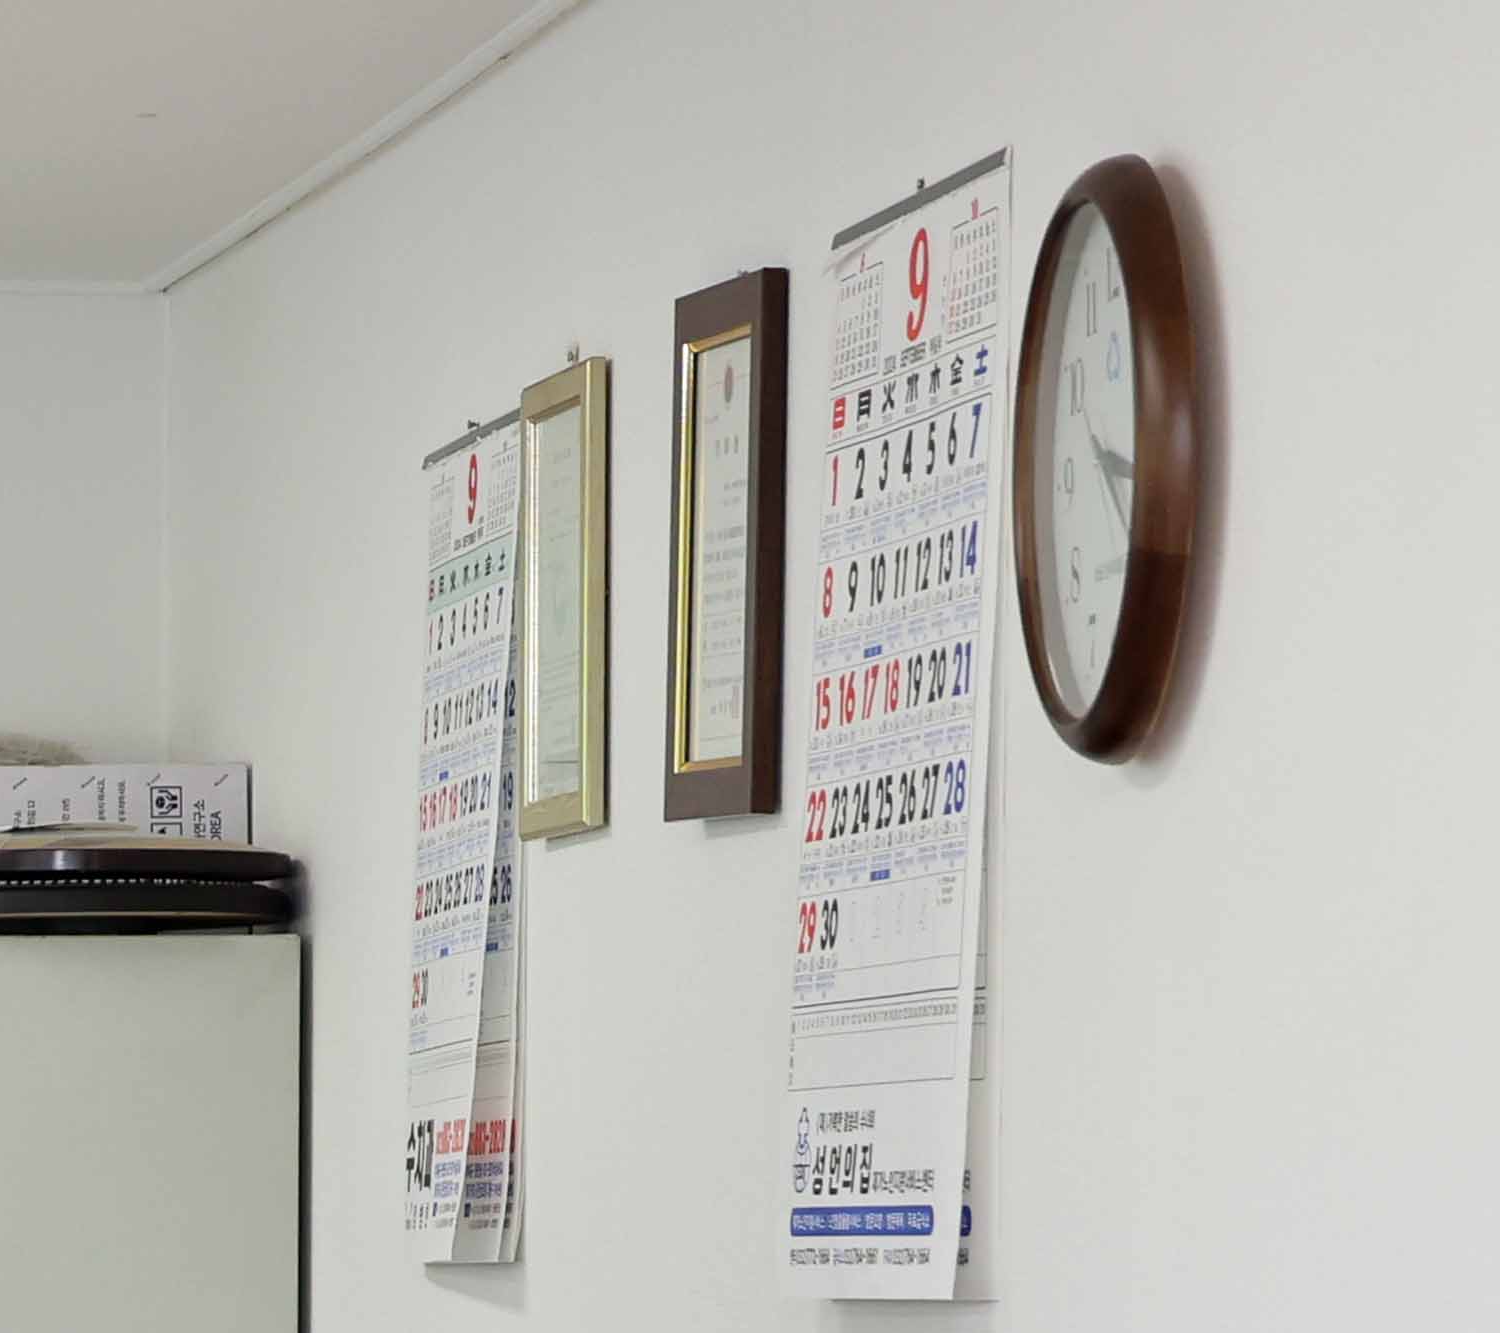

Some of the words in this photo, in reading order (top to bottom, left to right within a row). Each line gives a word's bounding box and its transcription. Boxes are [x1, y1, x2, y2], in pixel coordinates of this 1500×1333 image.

[906, 227, 930, 342] 9
[1064, 357, 1085, 417] 10
[467, 453, 478, 525] 9
[831, 454, 839, 507] 1
[854, 447, 866, 500] 2
[878, 439, 890, 491] 3
[902, 429, 914, 483] 4
[926, 421, 937, 475] 5
[947, 411, 958, 467] 6
[969, 402, 983, 459] 7
[822, 565, 834, 619] 8
[847, 560, 859, 613] 9
[869, 552, 887, 608] 10
[893, 543, 910, 600] 11
[914, 536, 933, 593] 12
[937, 529, 955, 586] 13
[959, 520, 979, 579] 14
[815, 677, 831, 731] 15
[839, 670, 856, 727] 16
[861, 663, 881, 721] 17
[884, 658, 901, 715] 18
[905, 653, 924, 709] 19
[927, 646, 948, 703] 20
[952, 639, 973, 697] 21
[805, 788, 827, 844] 22
[829, 784, 848, 840] 23
[851, 778, 871, 835] 24
[875, 774, 894, 831] 25
[898, 769, 917, 825] 26
[920, 763, 941, 820] 27
[943, 757, 967, 816] 28
[797, 900, 817, 954] 29
[820, 897, 839, 951] 30
